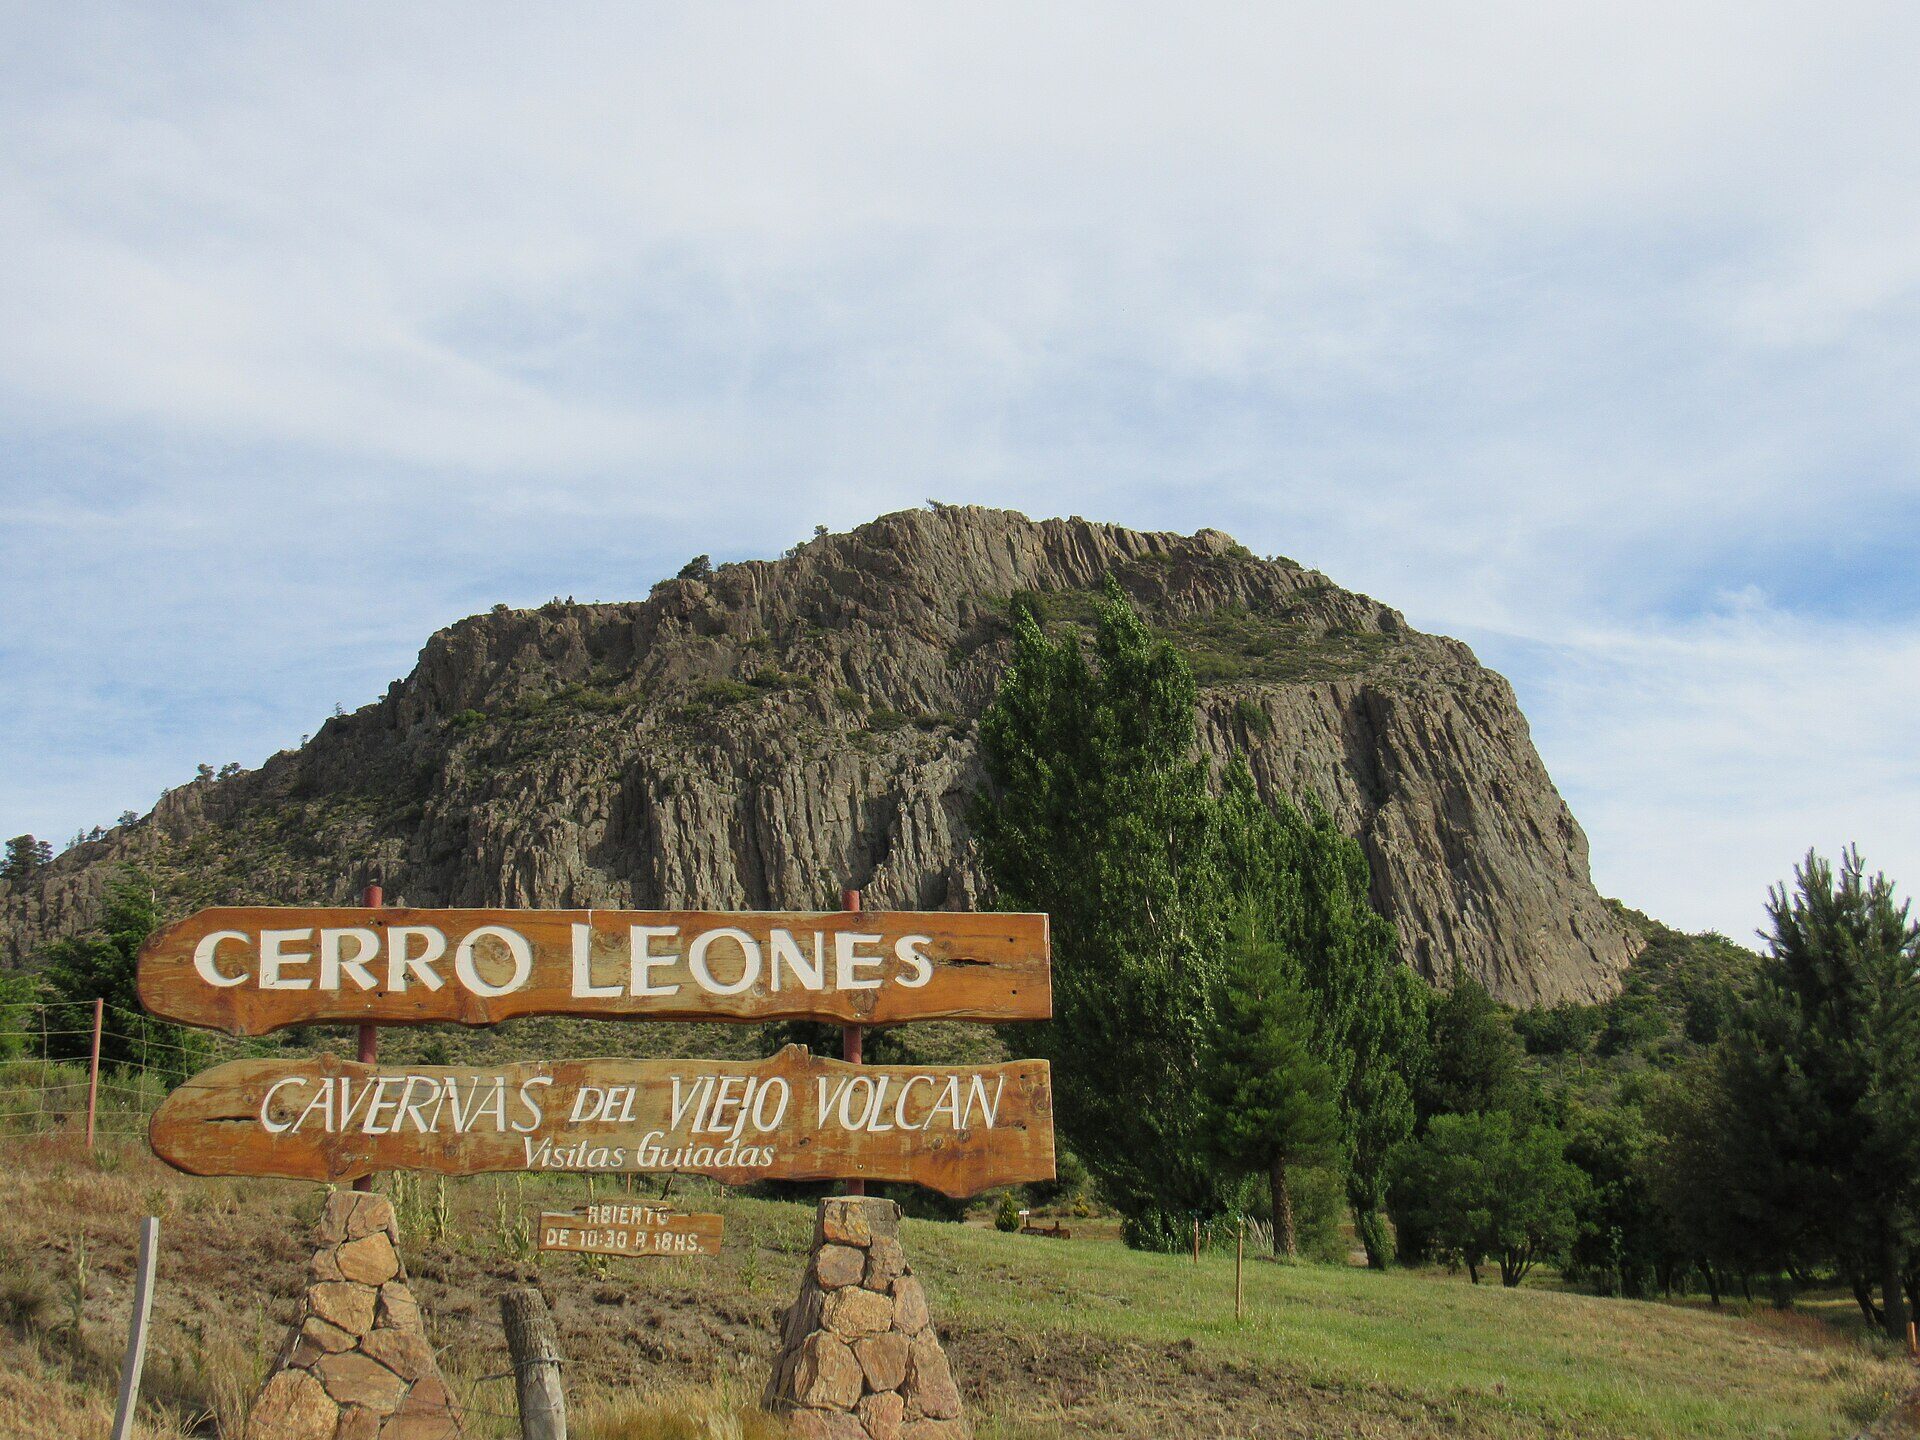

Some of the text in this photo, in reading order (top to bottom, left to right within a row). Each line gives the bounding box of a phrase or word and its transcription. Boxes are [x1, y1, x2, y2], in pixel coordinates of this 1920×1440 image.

[193, 922, 934, 998] CERRO LEONES
[260, 1074, 1005, 1143] CAVERNAS DEL VIEJO VOLCAN
[523, 1131, 774, 1169] Visitas Guiadas
[587, 1205, 670, 1226] ABIERTO
[546, 1228, 570, 1247] DE
[579, 1230, 628, 1249] 10:30
